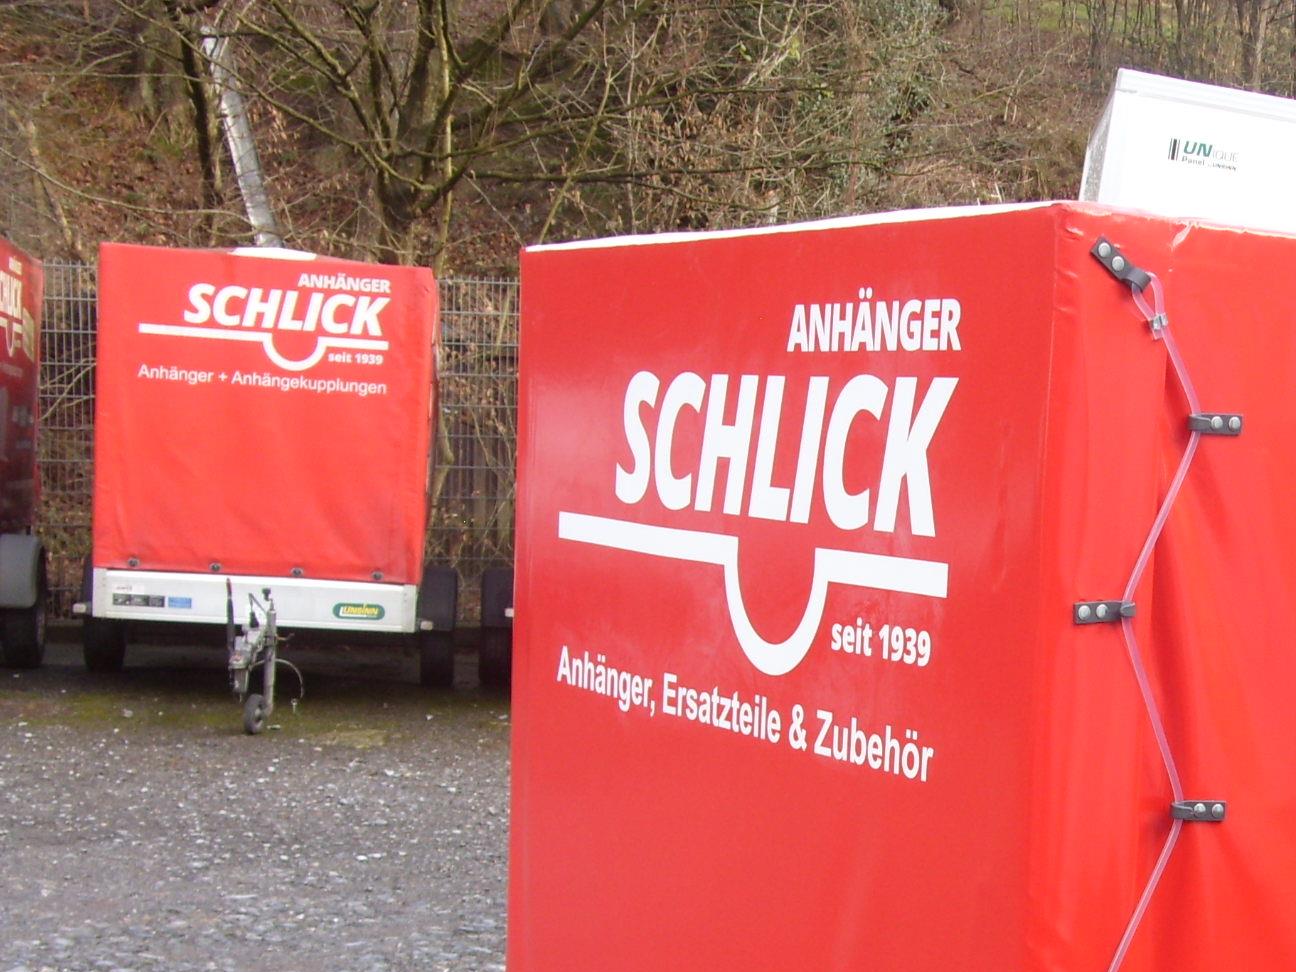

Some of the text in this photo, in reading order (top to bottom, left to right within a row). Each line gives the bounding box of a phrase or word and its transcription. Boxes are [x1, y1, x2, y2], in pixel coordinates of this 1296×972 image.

[298, 273, 390, 293] ANHÄNGER
[184, 283, 390, 336] SCHLICK
[787, 288, 961, 352] ANHÄNGER
[138, 364, 387, 396] Anhänger + Anhängekupplungen
[328, 353, 383, 365] seit 1939
[615, 370, 959, 537] SCHLICK
[831, 618, 931, 667] seit 1939
[557, 646, 934, 782] Anhänger, Ersatzteile & Zubehör
